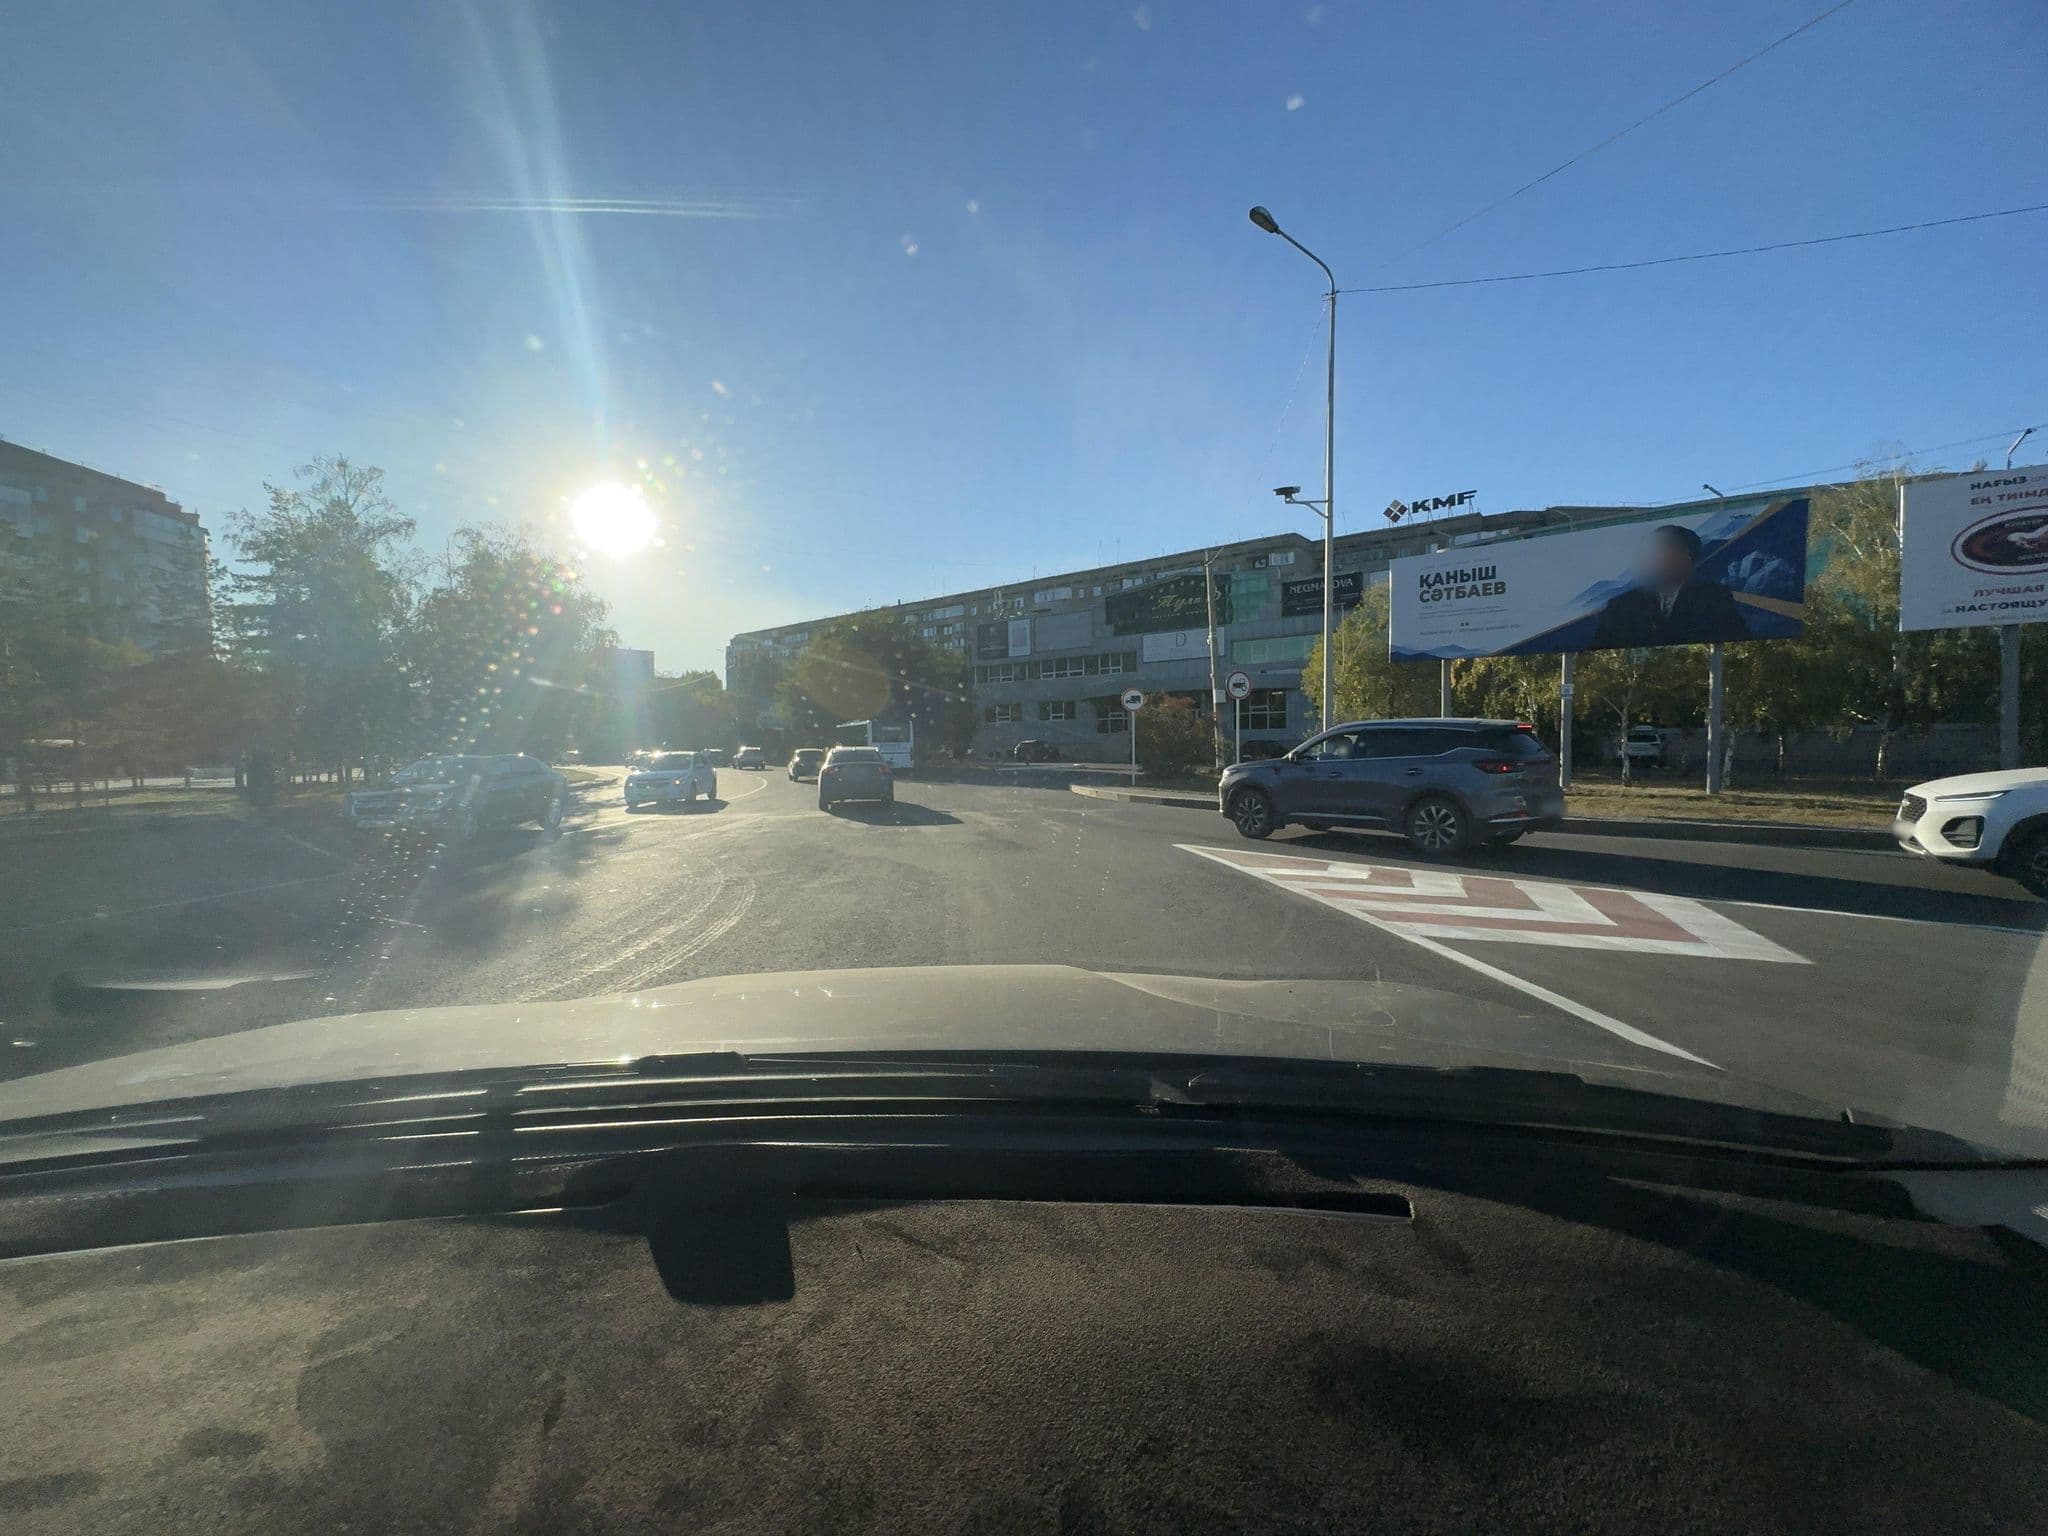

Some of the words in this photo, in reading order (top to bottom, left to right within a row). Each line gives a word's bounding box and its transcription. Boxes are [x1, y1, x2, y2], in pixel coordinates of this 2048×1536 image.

[1412, 489, 1477, 513] KMF
[1419, 565, 1497, 589] ҚАНЫШ
[1419, 581, 1506, 603] СӘТБАЕВ
[1973, 584, 2045, 597] ЛУЧШАЯ
